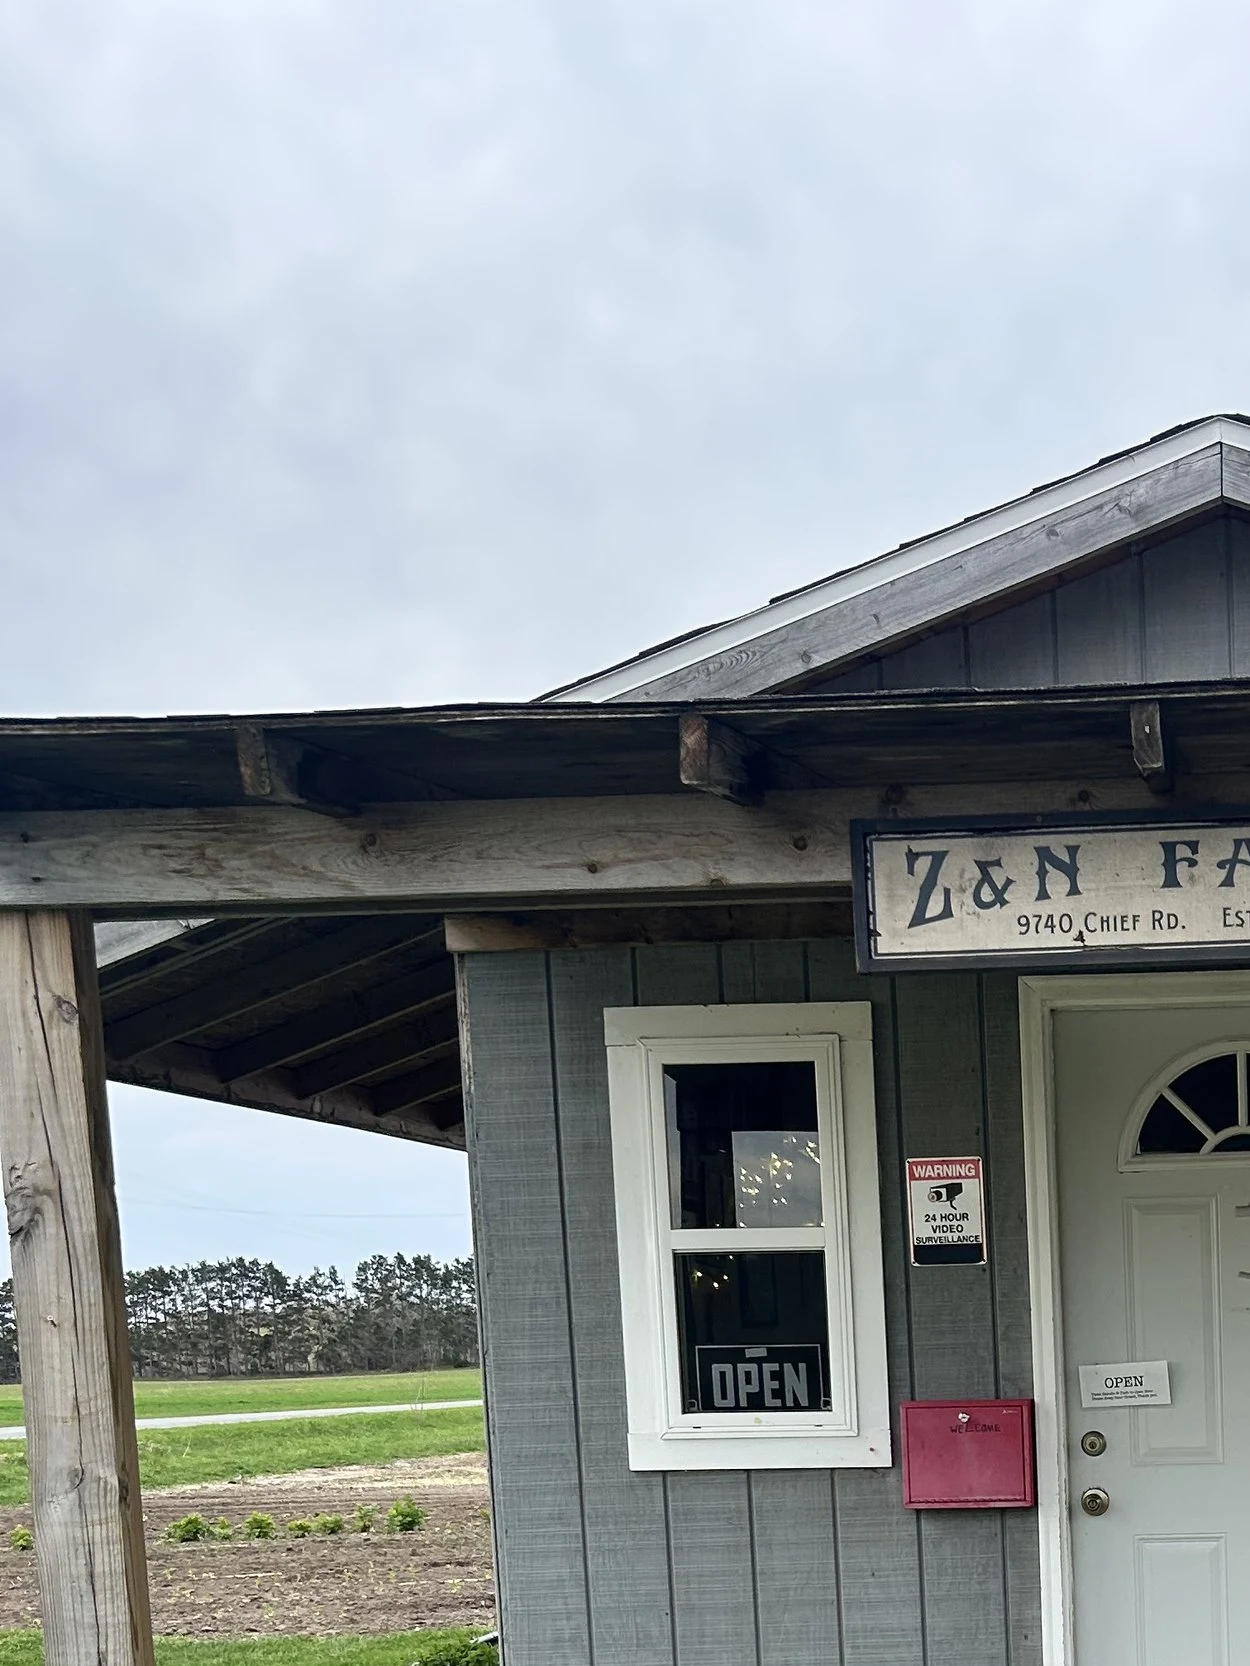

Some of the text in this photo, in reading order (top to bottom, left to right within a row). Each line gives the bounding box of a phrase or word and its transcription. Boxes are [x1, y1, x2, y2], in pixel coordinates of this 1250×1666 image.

[906, 844, 1083, 930] Z&N
[1016, 913, 1074, 935] 9740
[1084, 911, 1141, 933] CHIEF
[1151, 910, 1187, 931] RD.
[912, 1163, 976, 1178] WARNING
[924, 1212, 970, 1223] 24 HOUR
[931, 1224, 964, 1234] VIDEO
[915, 1234, 981, 1245] SURVEILLANCE
[711, 1362, 810, 1408] OPEN
[1104, 1375, 1144, 1389] OPEN
